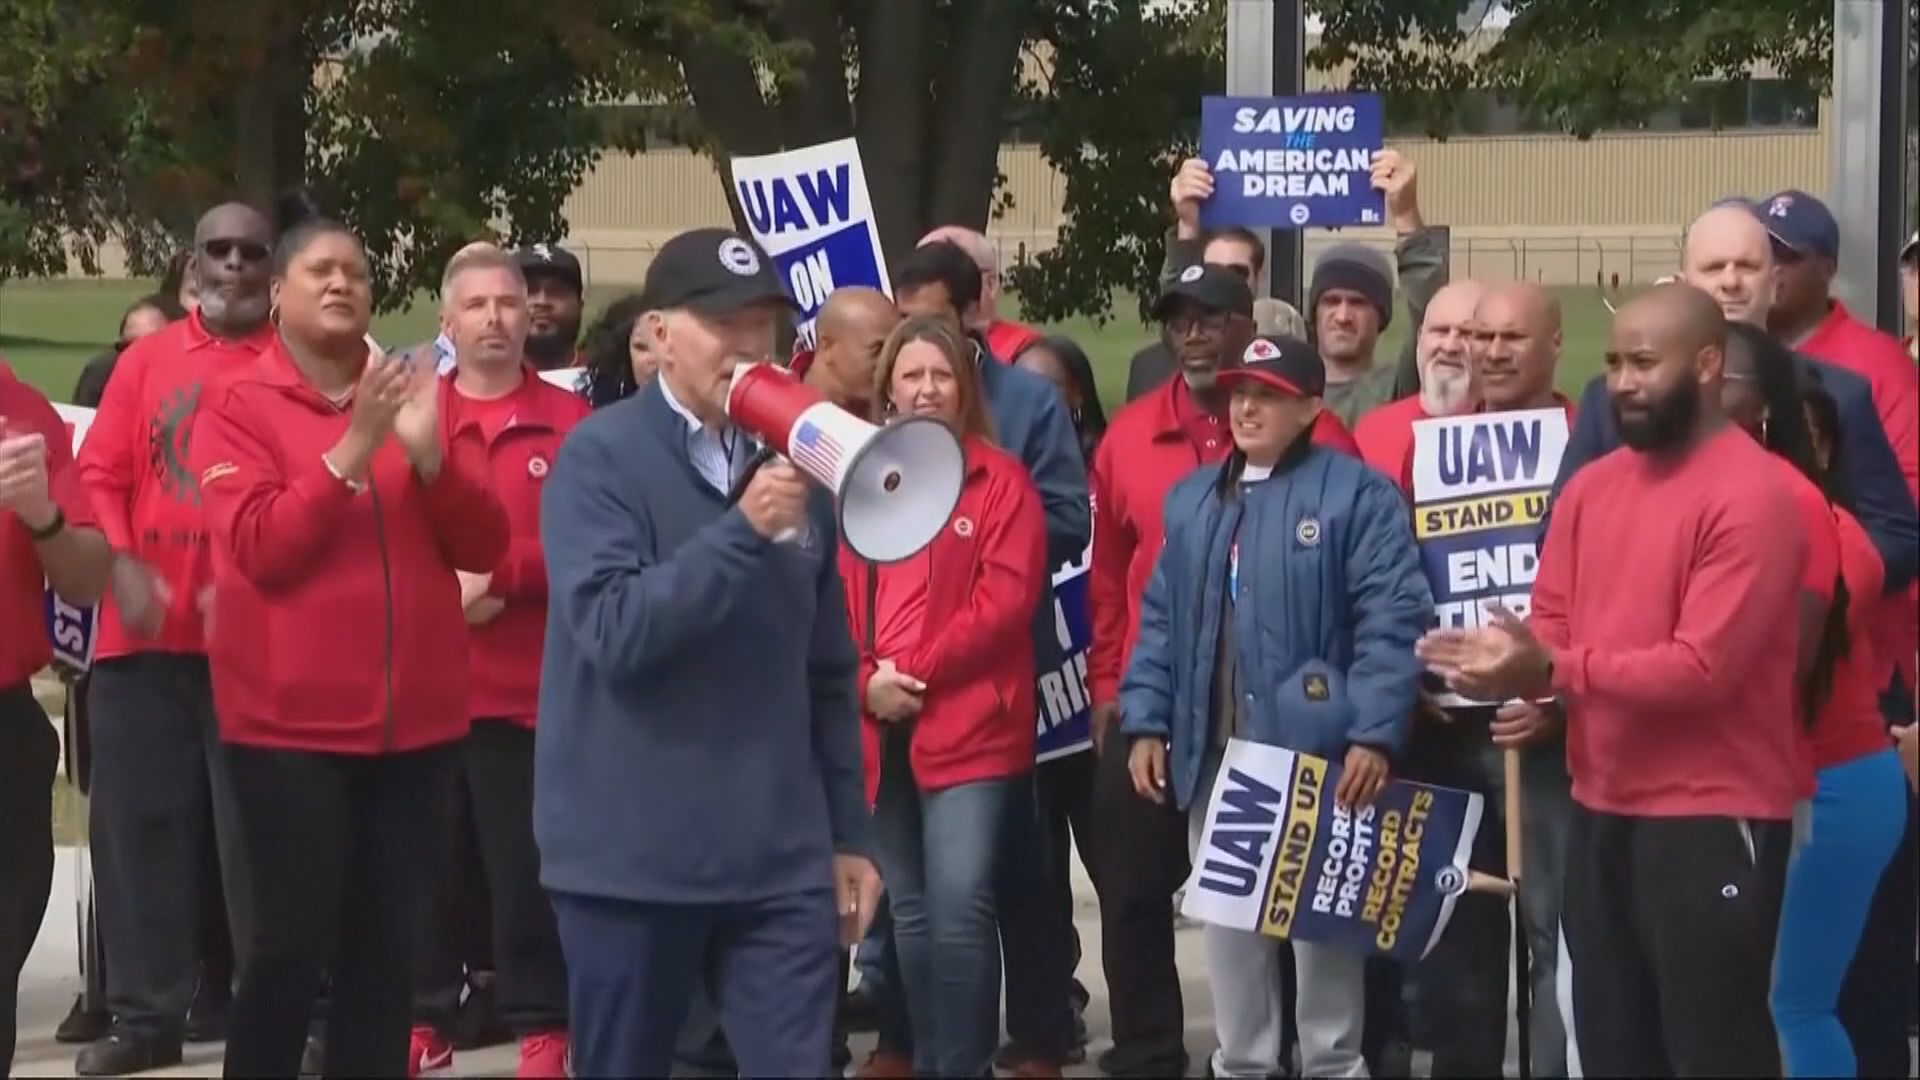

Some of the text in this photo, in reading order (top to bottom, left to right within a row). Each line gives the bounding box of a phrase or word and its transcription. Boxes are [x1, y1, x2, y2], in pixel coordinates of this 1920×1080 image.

[1233, 106, 1355, 133] SAVING
[1285, 134, 1316, 149] THE
[1215, 149, 1370, 172] AMERICAN
[1243, 174, 1349, 196] DREAM
[740, 163, 850, 235] UAW
[790, 247, 835, 312] ON
[1438, 419, 1541, 486] UAW
[1426, 500, 1514, 532] STAND
[1448, 543, 1540, 593] END
[1199, 767, 1282, 897] UAW
[1270, 766, 1318, 927] STAND UP
[1335, 803, 1376, 917] PROFITS
[1361, 810, 1401, 922] RECORD
[1376, 790, 1434, 949] CONTRACTS
